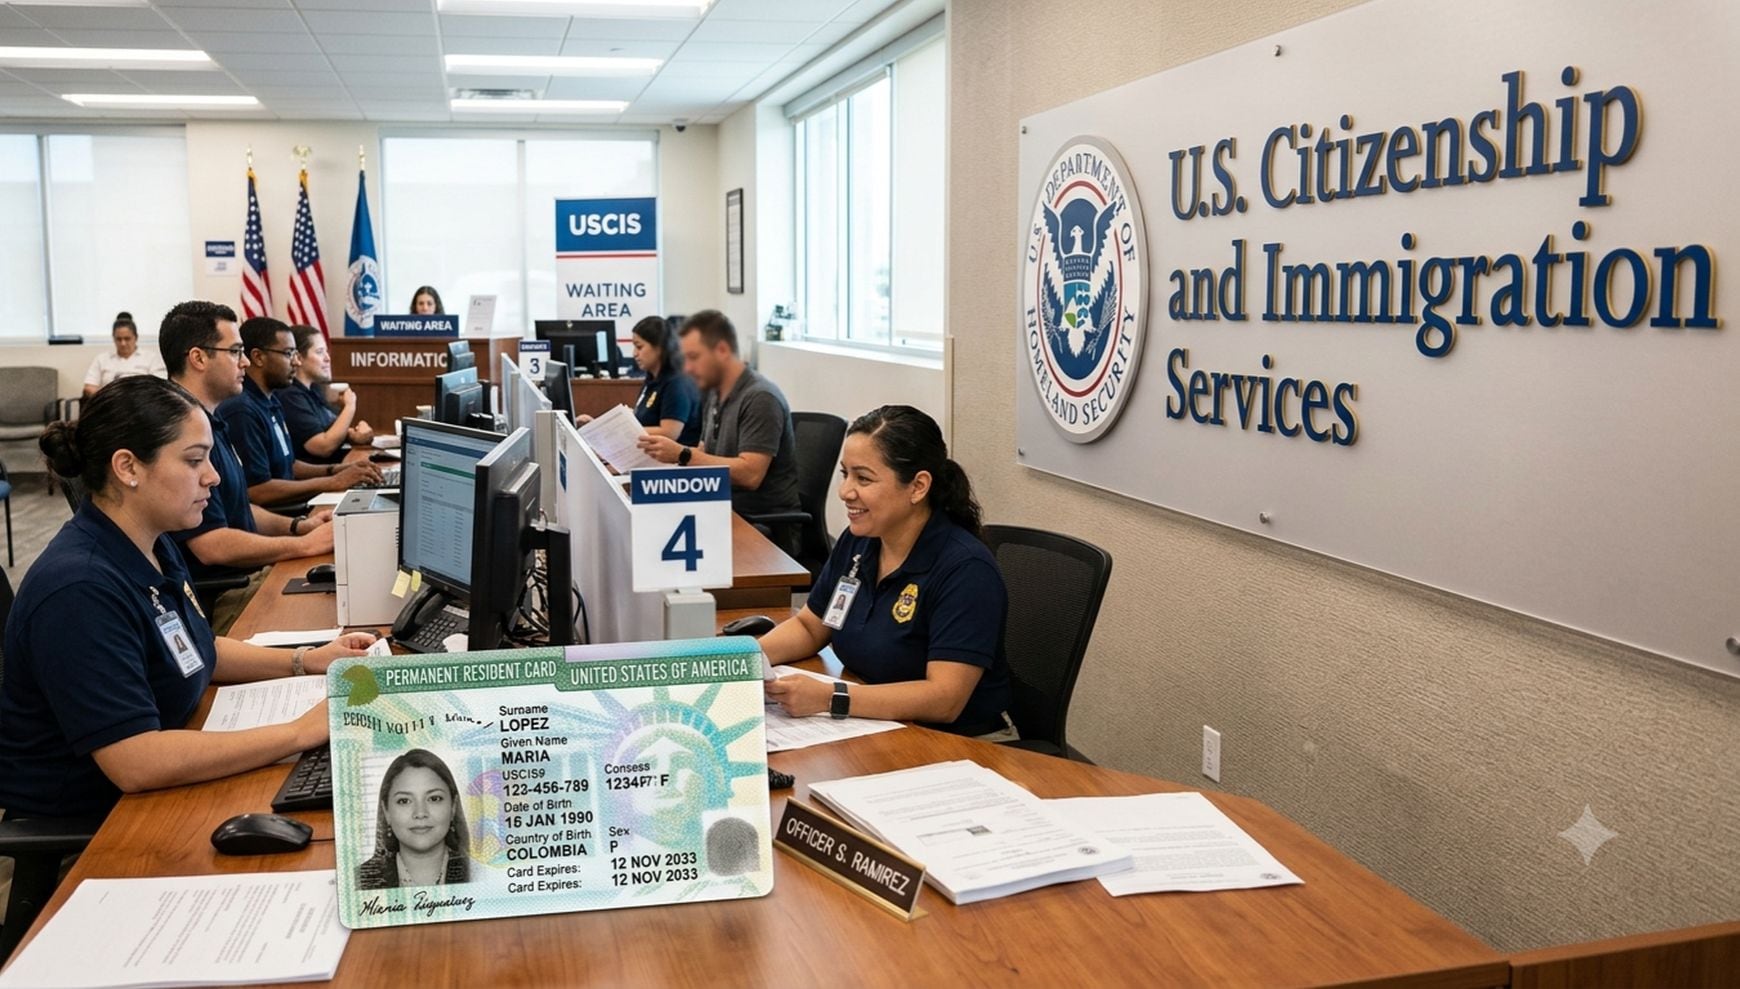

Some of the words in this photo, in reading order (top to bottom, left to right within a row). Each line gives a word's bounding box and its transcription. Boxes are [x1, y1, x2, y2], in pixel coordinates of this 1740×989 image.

[1168, 137, 1248, 220] U.S.
[1261, 66, 1643, 207] Citizenship
[569, 213, 642, 236] USCIS
[1120, 222, 1136, 263] OF
[566, 282, 646, 298] WAITING
[1168, 239, 1248, 321] and
[1262, 221, 1722, 358] Immigration
[581, 303, 632, 317] AREA
[380, 320, 423, 331] WAITING
[423, 320, 453, 331] AREA
[530, 358, 540, 374] 3
[1083, 305, 1135, 425] SECURITY
[1166, 347, 1358, 446] Services
[641, 477, 721, 495] WINDOW
[661, 514, 704, 571] 4
[386, 666, 459, 687] PERMANENT
[524, 661, 557, 679] CARD
[570, 667, 617, 685] UNITED
[621, 663, 668, 682] STATES
[691, 659, 749, 678] AMERICA
[499, 705, 548, 716] Surname
[500, 717, 549, 732] LOPEZ
[500, 737, 532, 749] Given
[535, 735, 568, 746] Name
[501, 750, 550, 765] MARIA
[503, 779, 589, 796] 123-456-789
[504, 802, 530, 813] Date
[532, 801, 544, 810] of
[525, 813, 555, 827] JAN
[560, 811, 593, 824] 1990
[552, 831, 564, 841] of
[566, 829, 592, 840] Birth
[609, 826, 630, 837] Sex
[506, 843, 588, 861] COLOMBIA
[786, 818, 835, 855] OFFICER
[836, 843, 847, 863] S.
[851, 851, 910, 896] RAMIREZ
[610, 858, 627, 870] 12
[631, 854, 661, 868] NOV
[665, 852, 697, 866] 2033
[507, 866, 533, 878] Card
[537, 864, 581, 876] Expires:
[611, 873, 628, 886] 12
[632, 871, 662, 885] NOV
[666, 868, 698, 882] 2033
[508, 881, 534, 893] Card
[538, 879, 582, 892] Expires:
